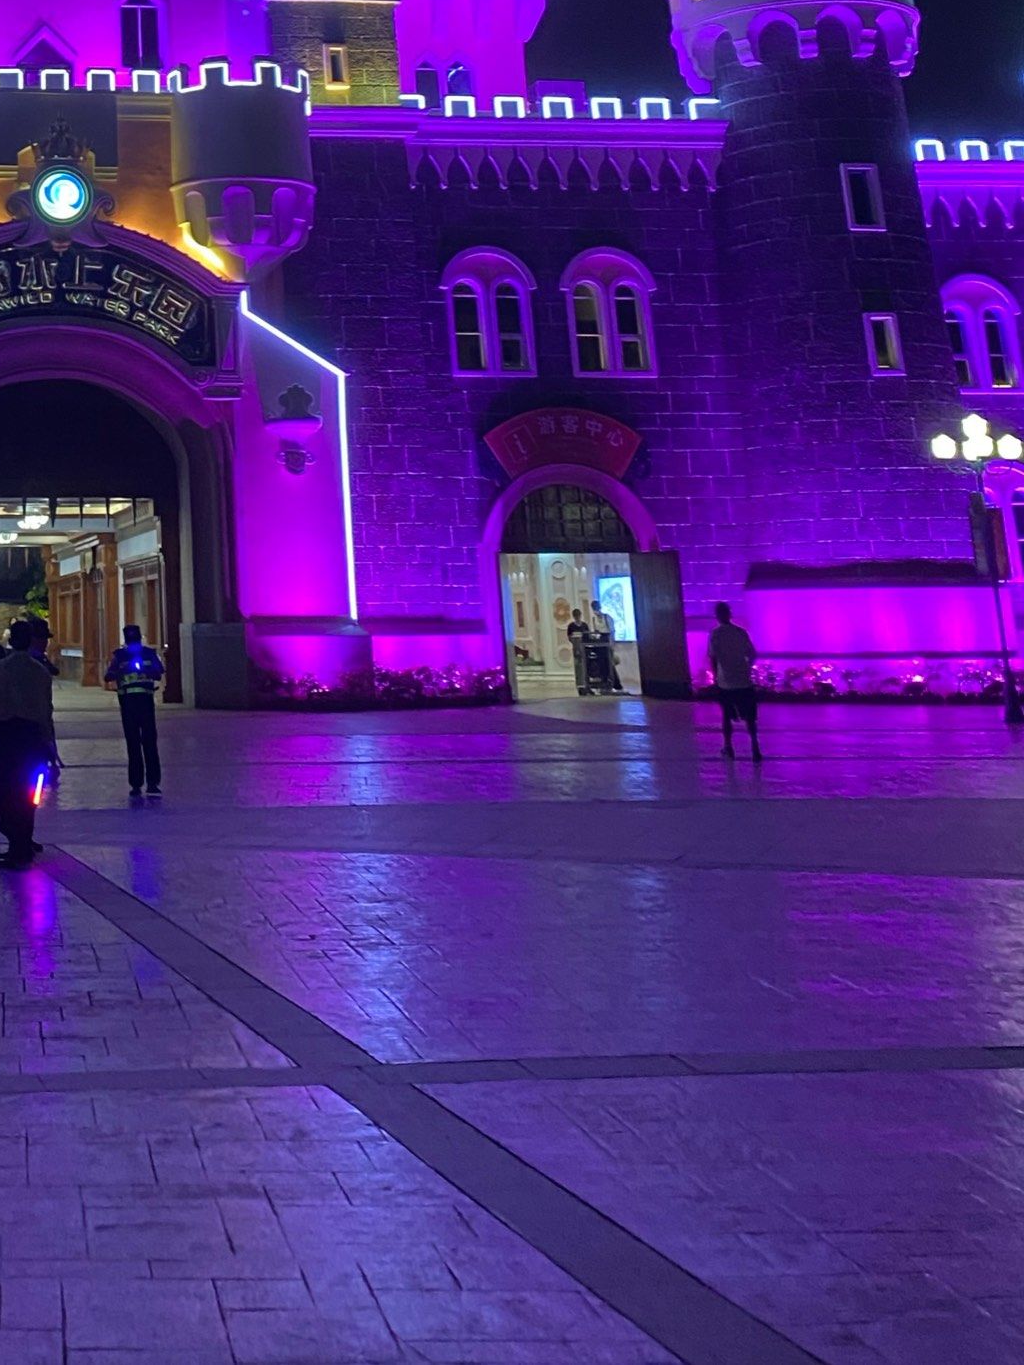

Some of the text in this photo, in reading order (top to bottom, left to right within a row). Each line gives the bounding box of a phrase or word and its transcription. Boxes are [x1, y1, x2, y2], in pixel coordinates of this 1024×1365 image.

[65, 292, 130, 316] WATER
[133, 311, 180, 346] PARK
[536, 415, 624, 447] 游客中心
